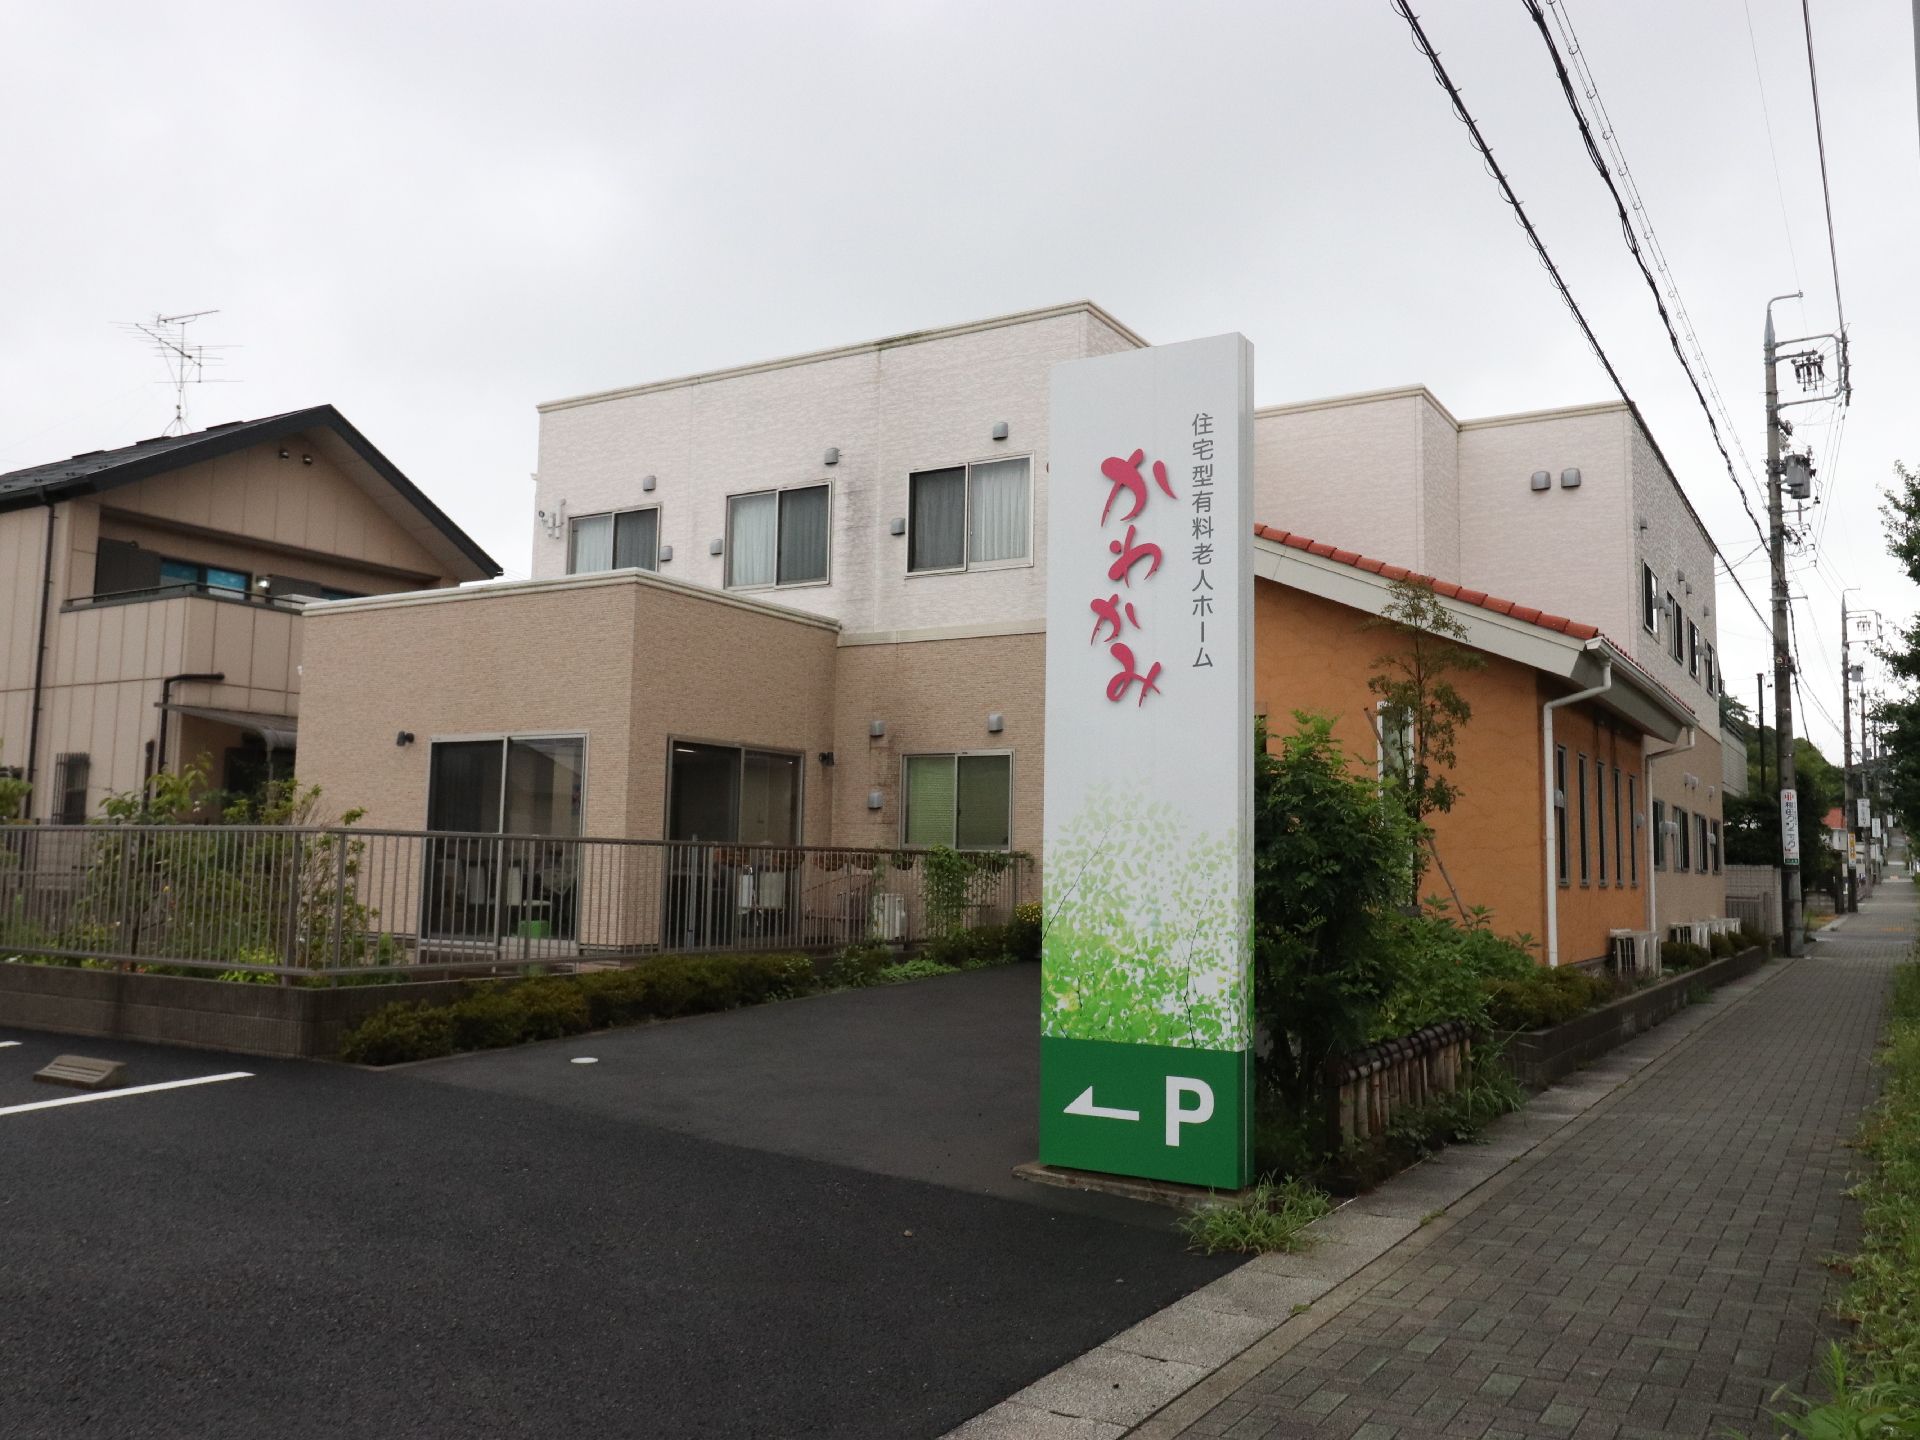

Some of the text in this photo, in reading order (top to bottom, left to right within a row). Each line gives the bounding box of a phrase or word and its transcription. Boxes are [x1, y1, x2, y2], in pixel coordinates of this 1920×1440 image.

[1090, 448, 1178, 707] かわかみ
[1192, 412, 1213, 668] 住宅型有料老人ホーム
[1165, 1075, 1215, 1147] P
